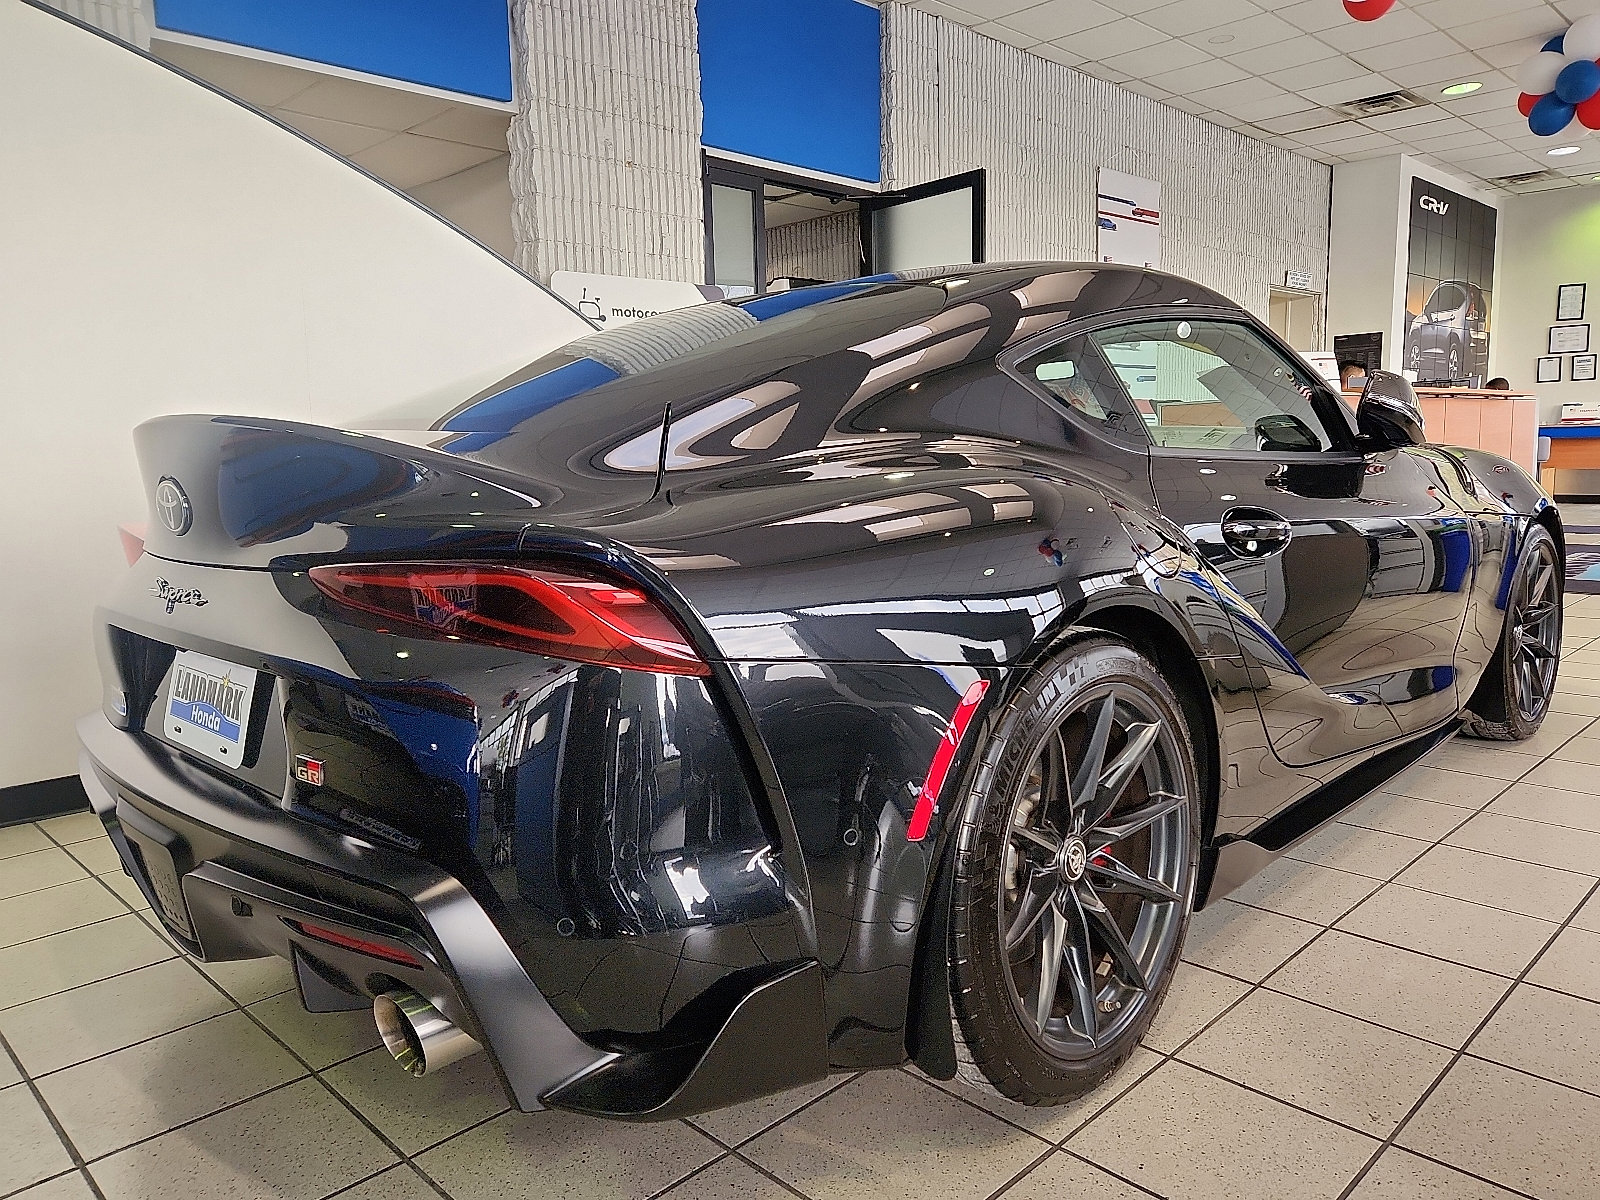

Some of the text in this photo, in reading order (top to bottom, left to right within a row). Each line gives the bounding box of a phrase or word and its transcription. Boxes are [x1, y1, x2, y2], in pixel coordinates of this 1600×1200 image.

[1419, 195, 1450, 216] CR-V
[611, 306, 662, 319] motoco
[149, 575, 209, 615] Supra
[173, 664, 247, 722] LANDMARK
[190, 704, 221, 732] Honda
[994, 680, 1058, 800] MICHELIN
[297, 766, 320, 784] GR
